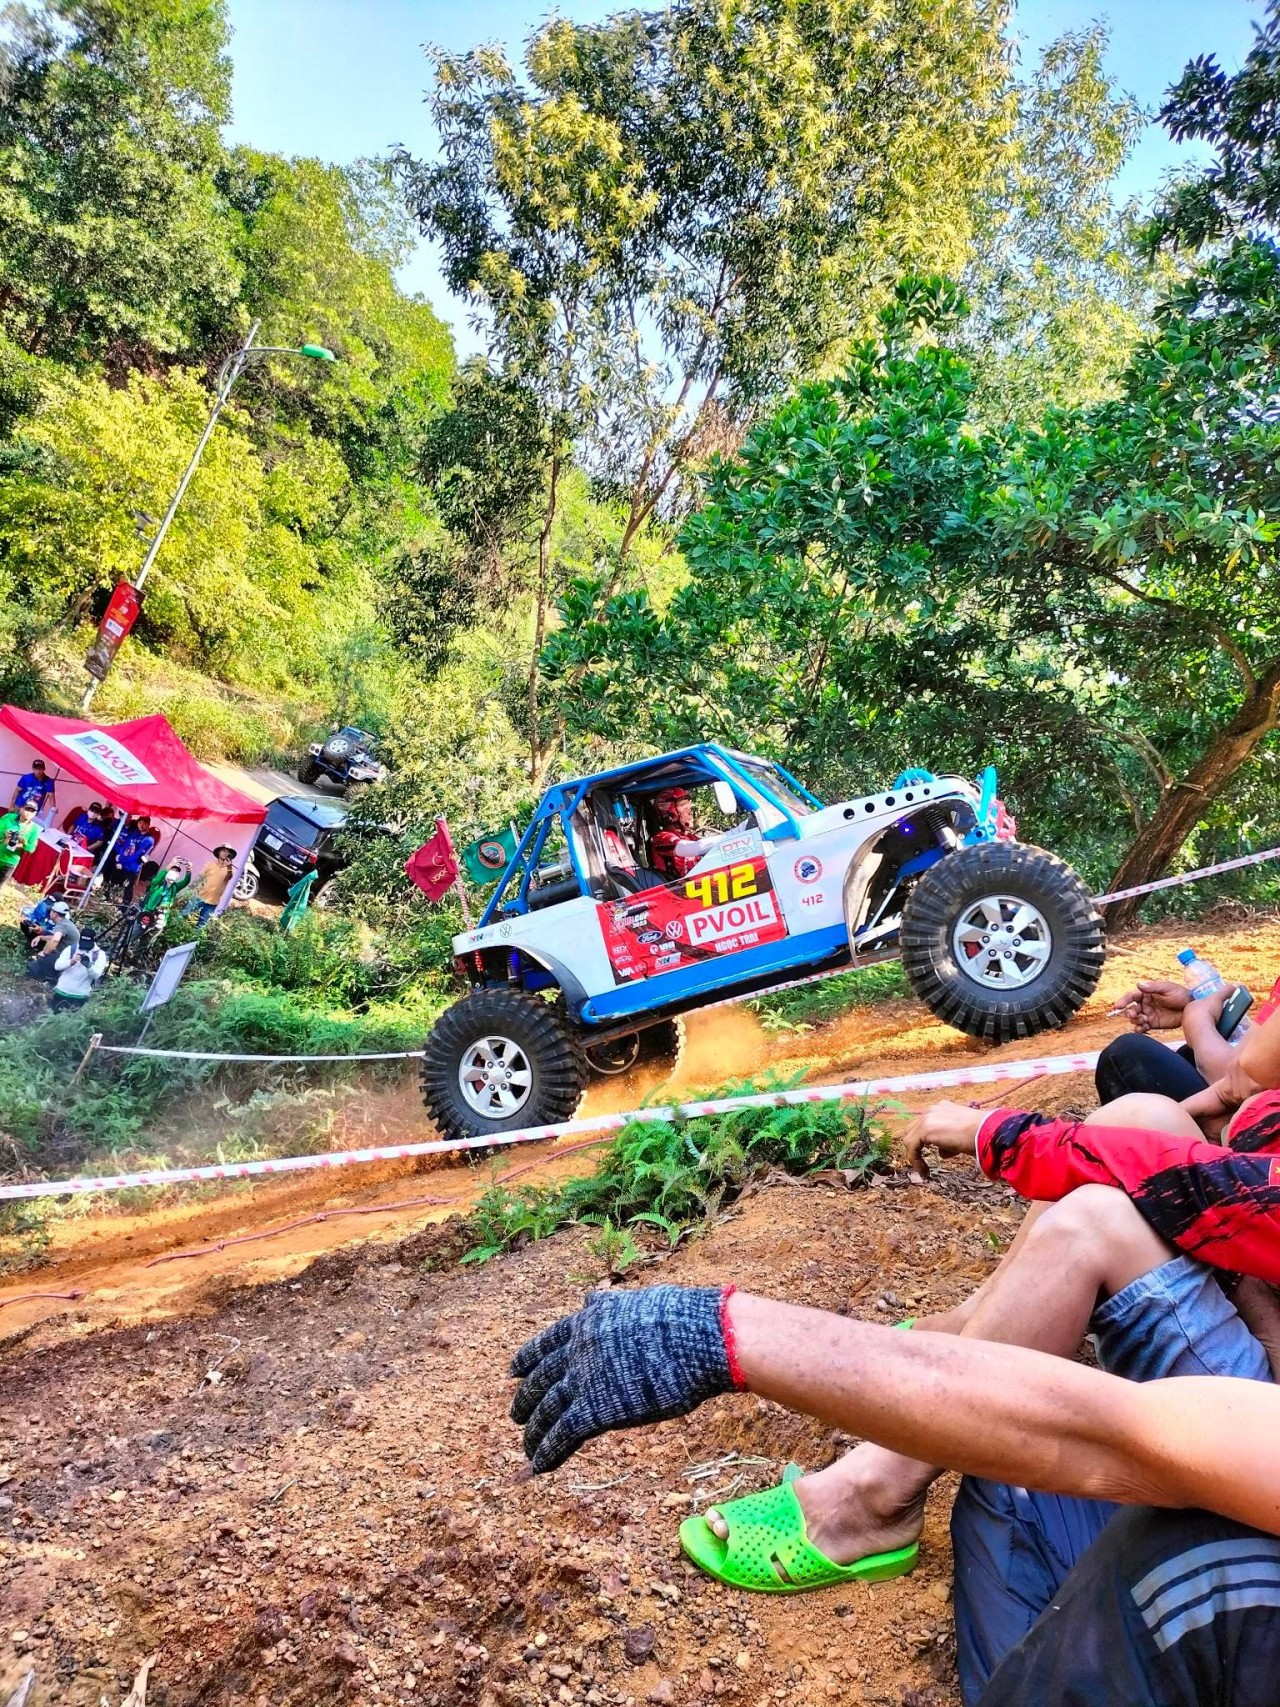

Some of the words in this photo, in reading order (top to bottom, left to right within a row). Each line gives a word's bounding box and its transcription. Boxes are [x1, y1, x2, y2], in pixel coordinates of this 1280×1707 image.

[91, 744, 139, 781] PVOIL
[685, 864, 757, 907] 412
[802, 893, 823, 906] 412
[692, 901, 771, 938] PVOIL
